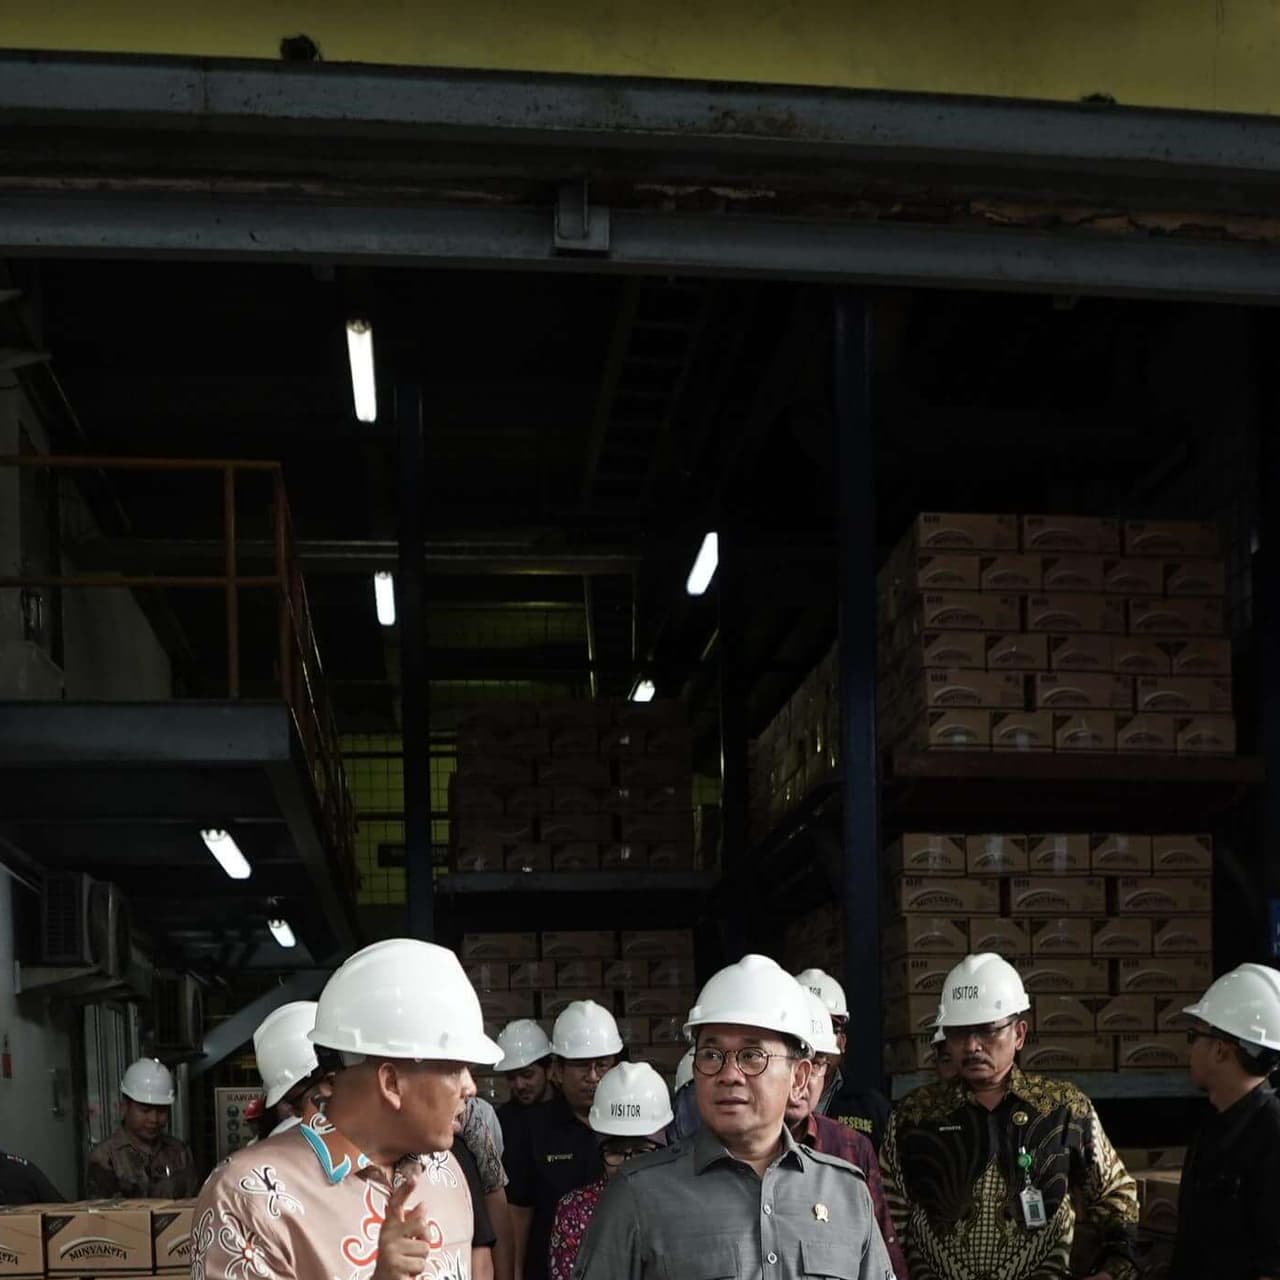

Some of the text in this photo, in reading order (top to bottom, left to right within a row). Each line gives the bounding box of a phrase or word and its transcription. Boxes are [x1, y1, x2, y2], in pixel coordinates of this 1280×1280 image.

[952, 986, 979, 1000] VISITOR
[610, 1103, 640, 1117] VISITOR
[68, 1246, 127, 1261] MINYAKITA
